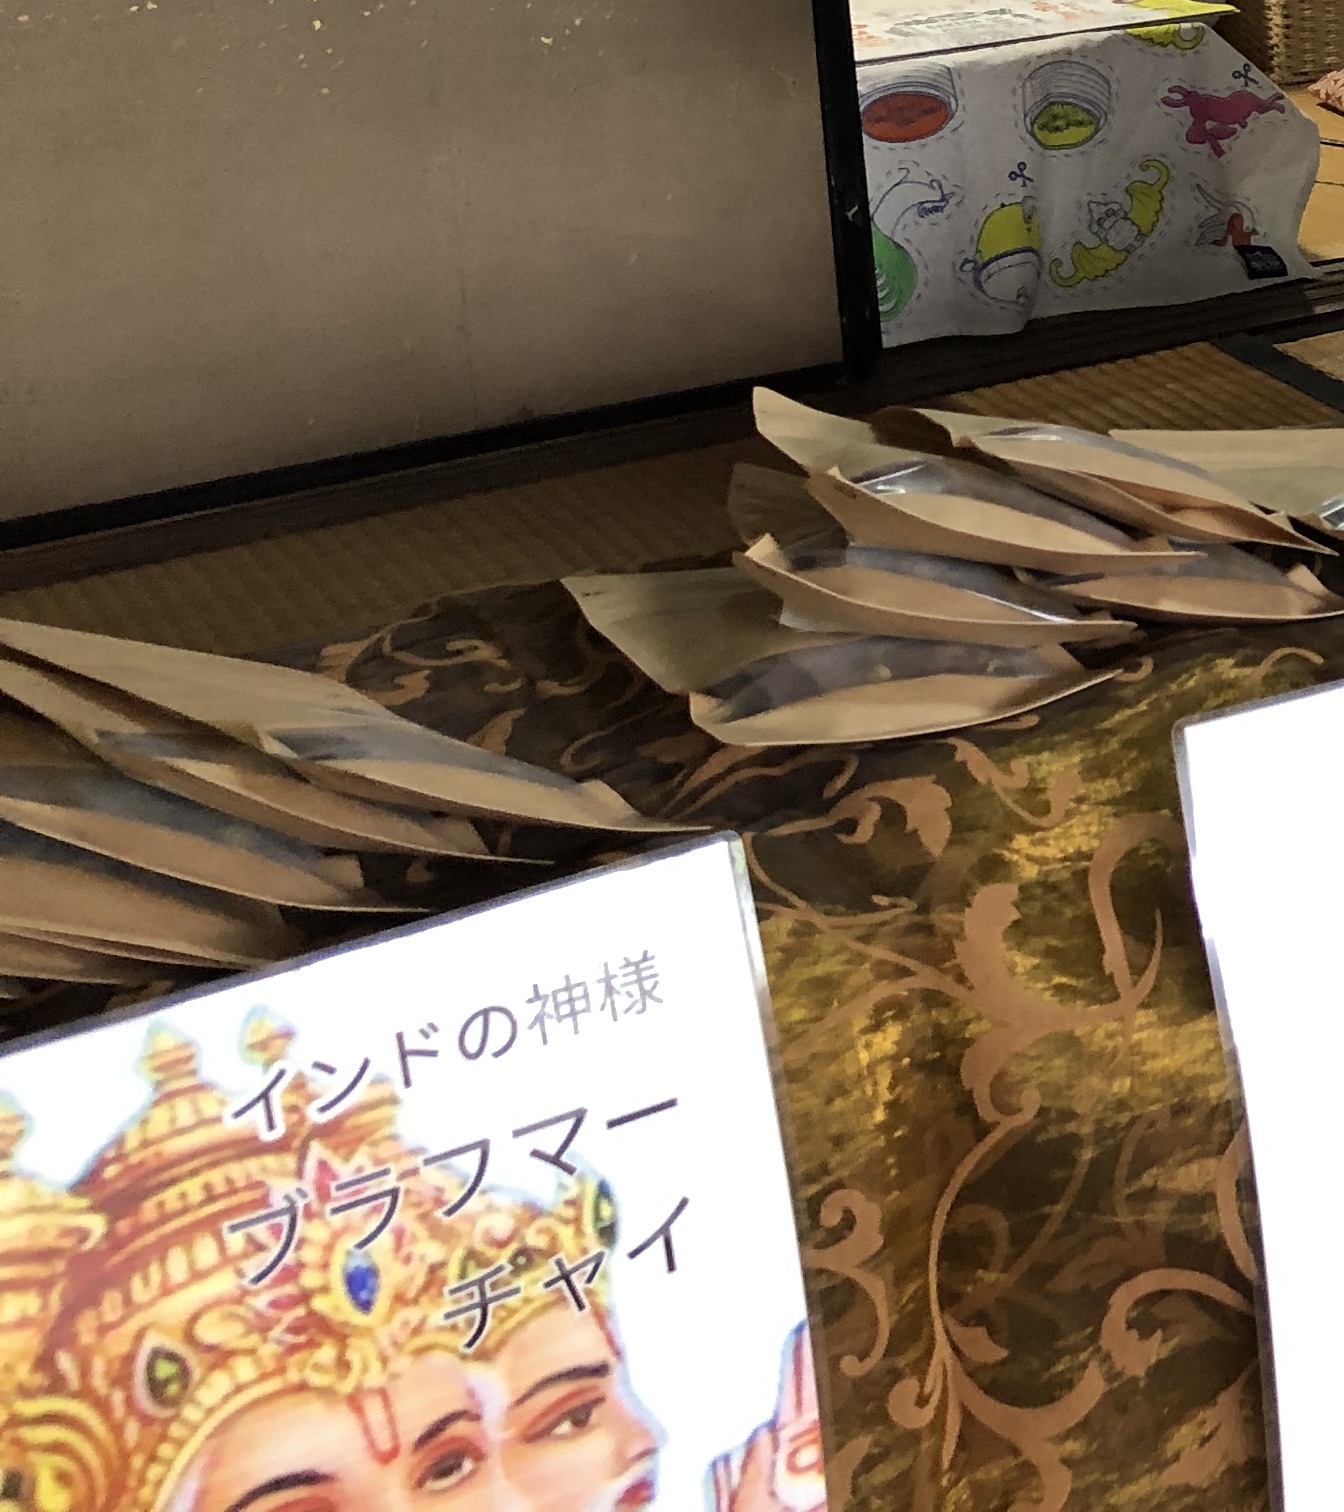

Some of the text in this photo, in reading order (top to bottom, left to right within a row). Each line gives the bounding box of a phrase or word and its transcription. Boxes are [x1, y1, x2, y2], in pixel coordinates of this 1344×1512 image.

[230, 950, 664, 1133] インドの神様
[226, 1098, 678, 1285] ブラフマー
[444, 1196, 690, 1350] チャイ
